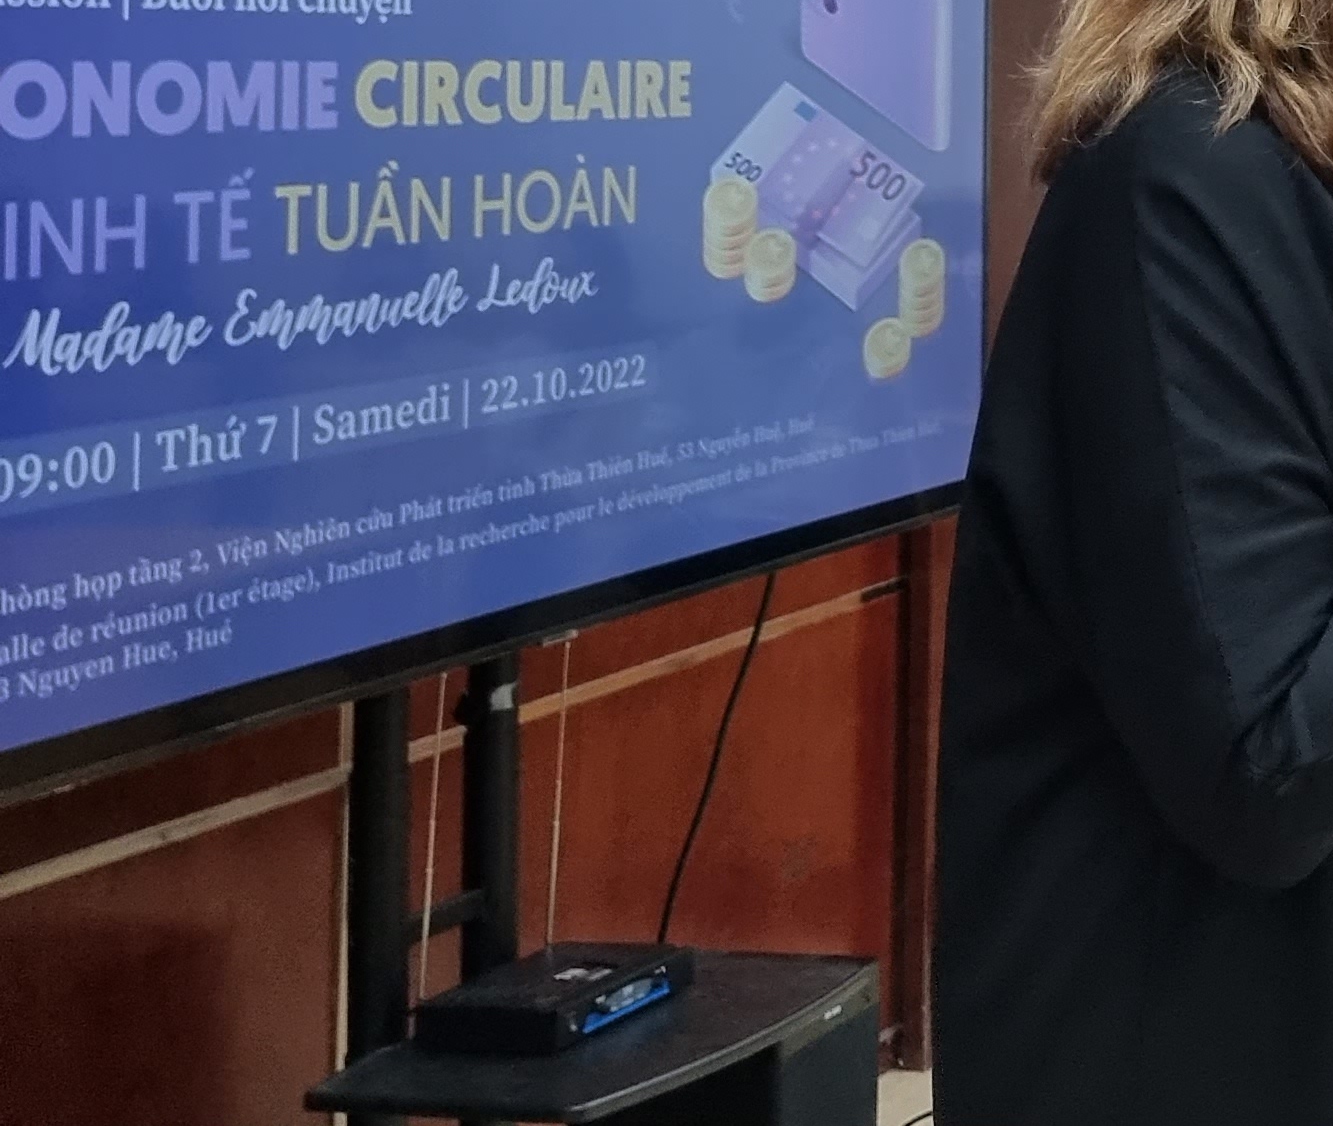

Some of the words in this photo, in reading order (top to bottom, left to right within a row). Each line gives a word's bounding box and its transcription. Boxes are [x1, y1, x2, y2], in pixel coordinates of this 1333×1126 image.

[0, 58, 339, 140] ONOMIE
[355, 59, 692, 128] CIRCULAIRE
[724, 151, 763, 184] 500
[850, 150, 907, 201] 500
[5, 193, 146, 280] INH
[173, 167, 255, 263] TẾ
[275, 159, 450, 255] TUẦN
[474, 153, 636, 237] HOÀN
[2, 301, 213, 376] Madame
[224, 267, 468, 350] Emmanuelle
[476, 256, 599, 315] Ledoux
[155, 414, 247, 472] Thứ
[257, 414, 278, 454] 7
[313, 382, 450, 445] Samedi
[481, 354, 646, 414] 22.10.2022
[51, 623, 83, 652] de
[91, 602, 188, 643] réunion
[194, 589, 243, 622] (1er
[327, 549, 405, 585] Institut
[408, 539, 432, 564] de
[436, 532, 455, 556] la
[458, 512, 550, 552] recherche
[73, 569, 123, 601] họp
[189, 548, 210, 574] 2,
[216, 535, 268, 567] Viện
[18, 655, 115, 699] Nguyen
